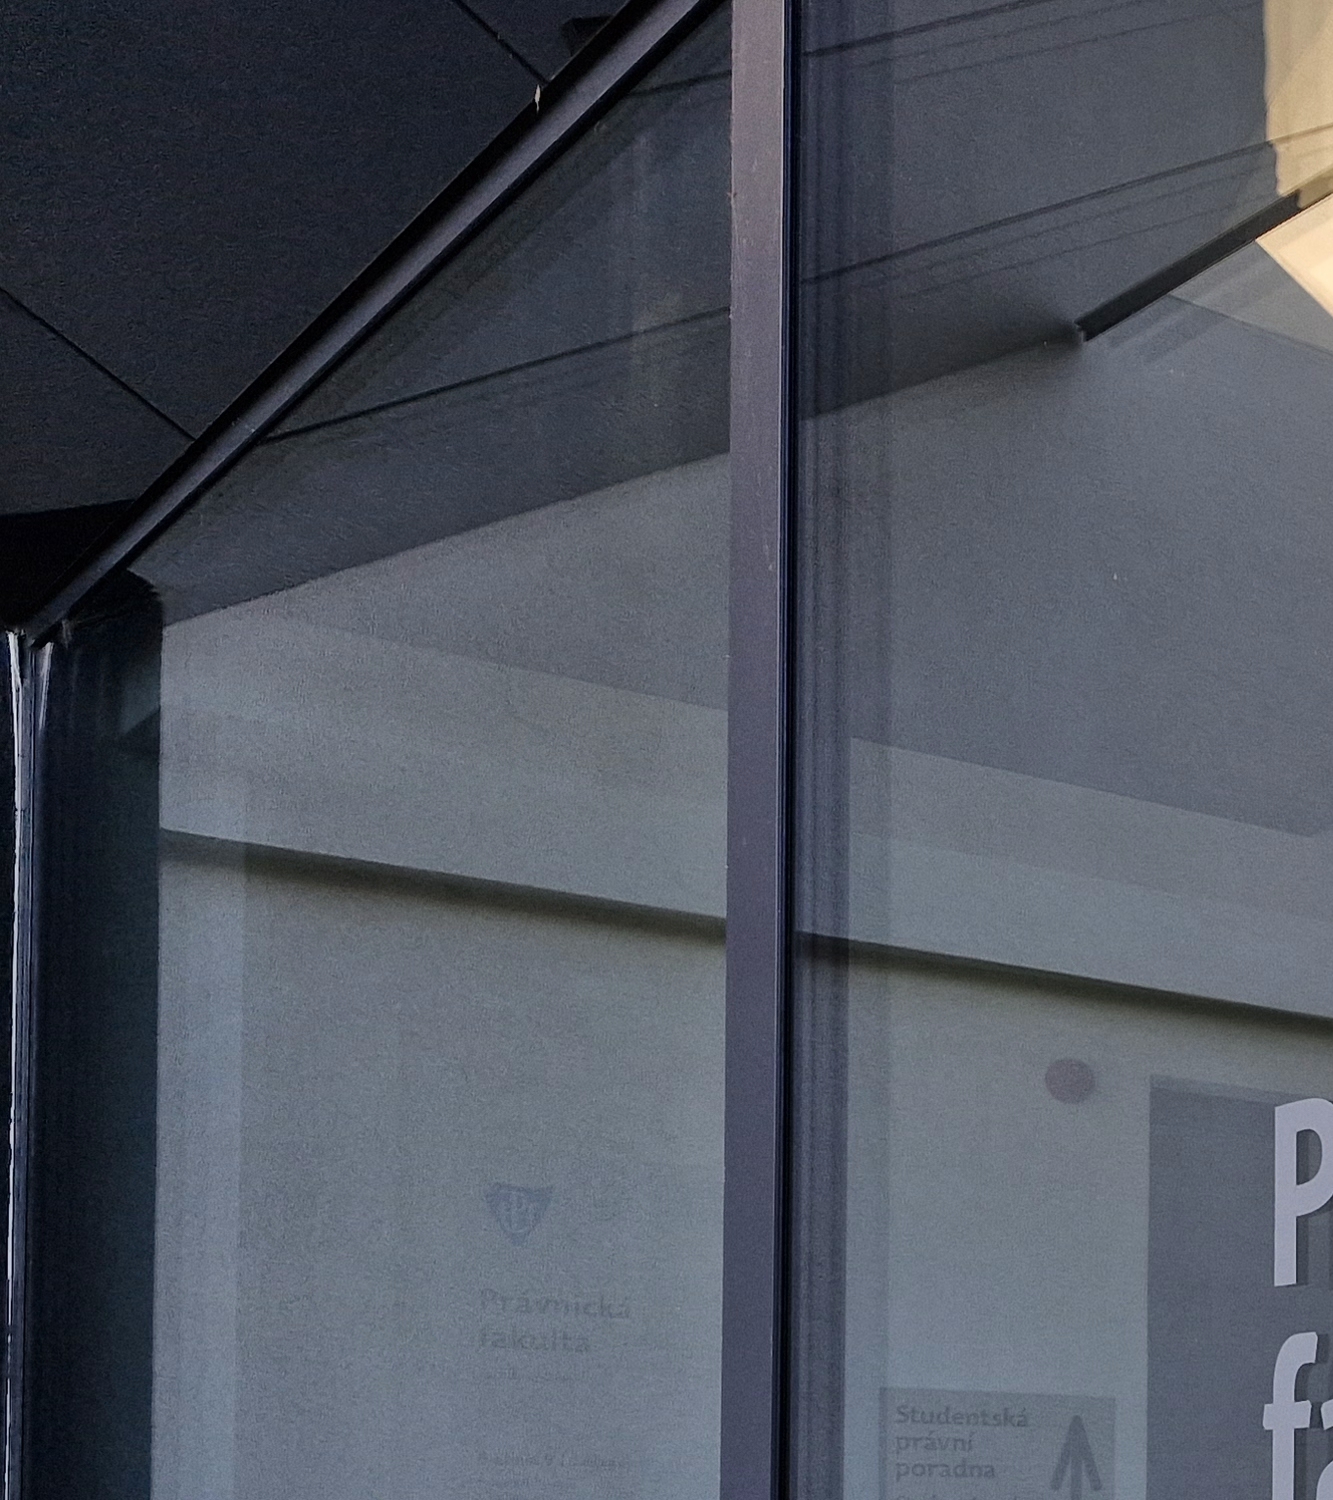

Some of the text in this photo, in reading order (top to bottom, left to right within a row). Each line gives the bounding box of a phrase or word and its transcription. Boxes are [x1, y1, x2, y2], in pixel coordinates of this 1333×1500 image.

[894, 1403, 1029, 1428] Studentská
[895, 1431, 977, 1455] právní
[895, 1458, 996, 1482] poradna
